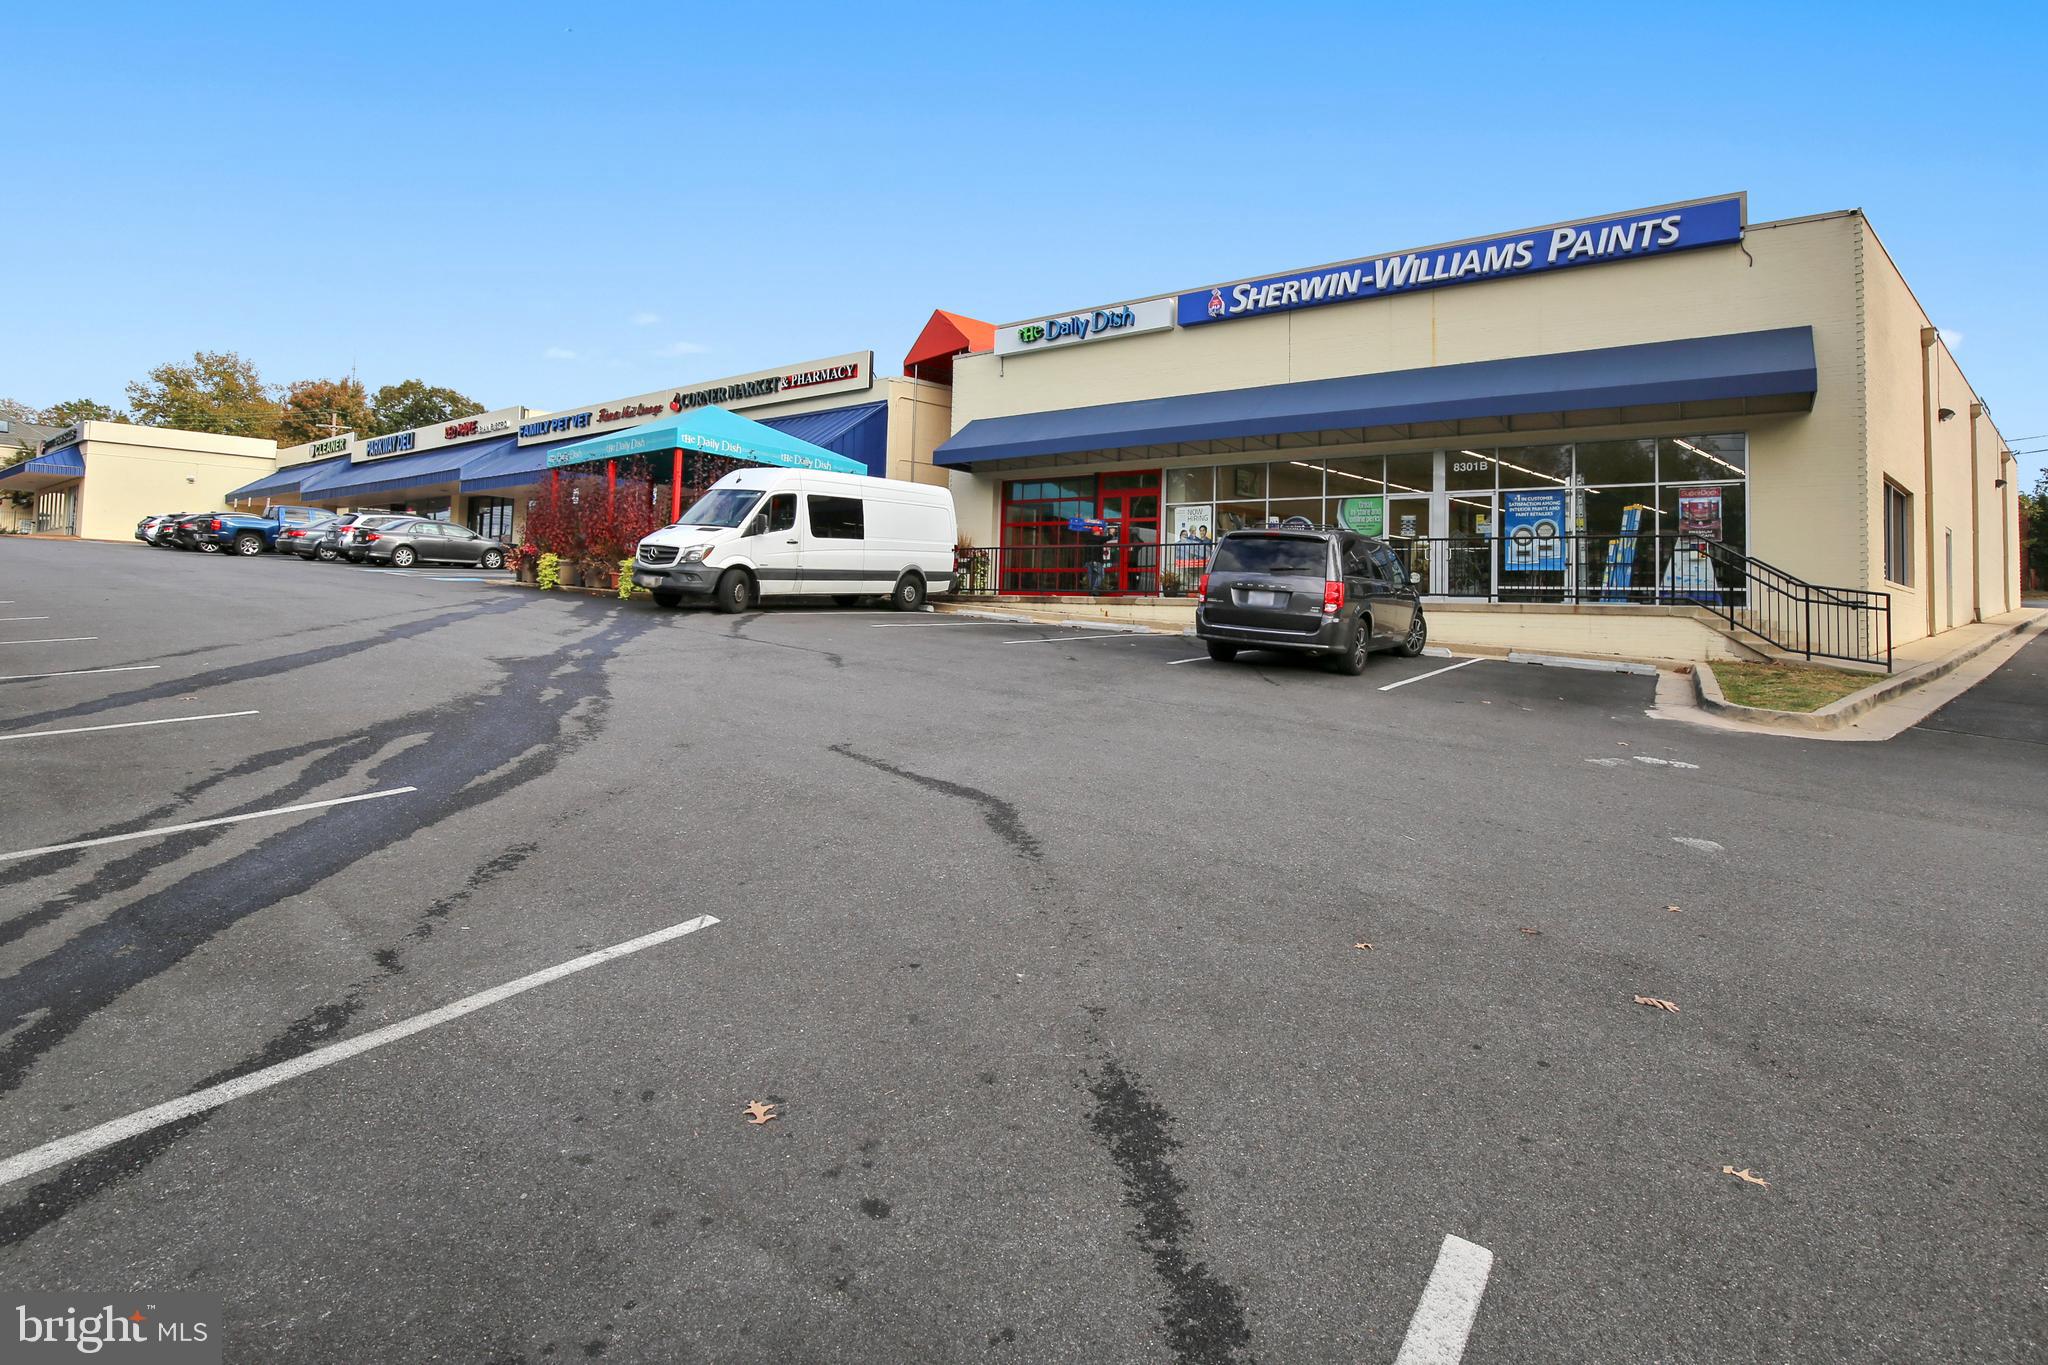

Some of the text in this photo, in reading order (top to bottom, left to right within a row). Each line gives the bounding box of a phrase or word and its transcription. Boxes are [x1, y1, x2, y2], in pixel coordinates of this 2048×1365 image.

[1547, 215, 1681, 264] PAINTS
[1045, 316, 1089, 341] Daily
[1090, 305, 1135, 333] Dish
[680, 364, 854, 408] CORNER MARKET & PHARMACY
[519, 412, 592, 438] FAMILY PET VET
[367, 432, 415, 456] PARKWAY DELI
[697, 435, 720, 450] Daily
[722, 440, 742, 453] Dish
[794, 454, 813, 466] Daily
[814, 458, 832, 470] Dish
[1453, 461, 1488, 472] 8301B
[1187, 514, 1209, 522] HIRING
